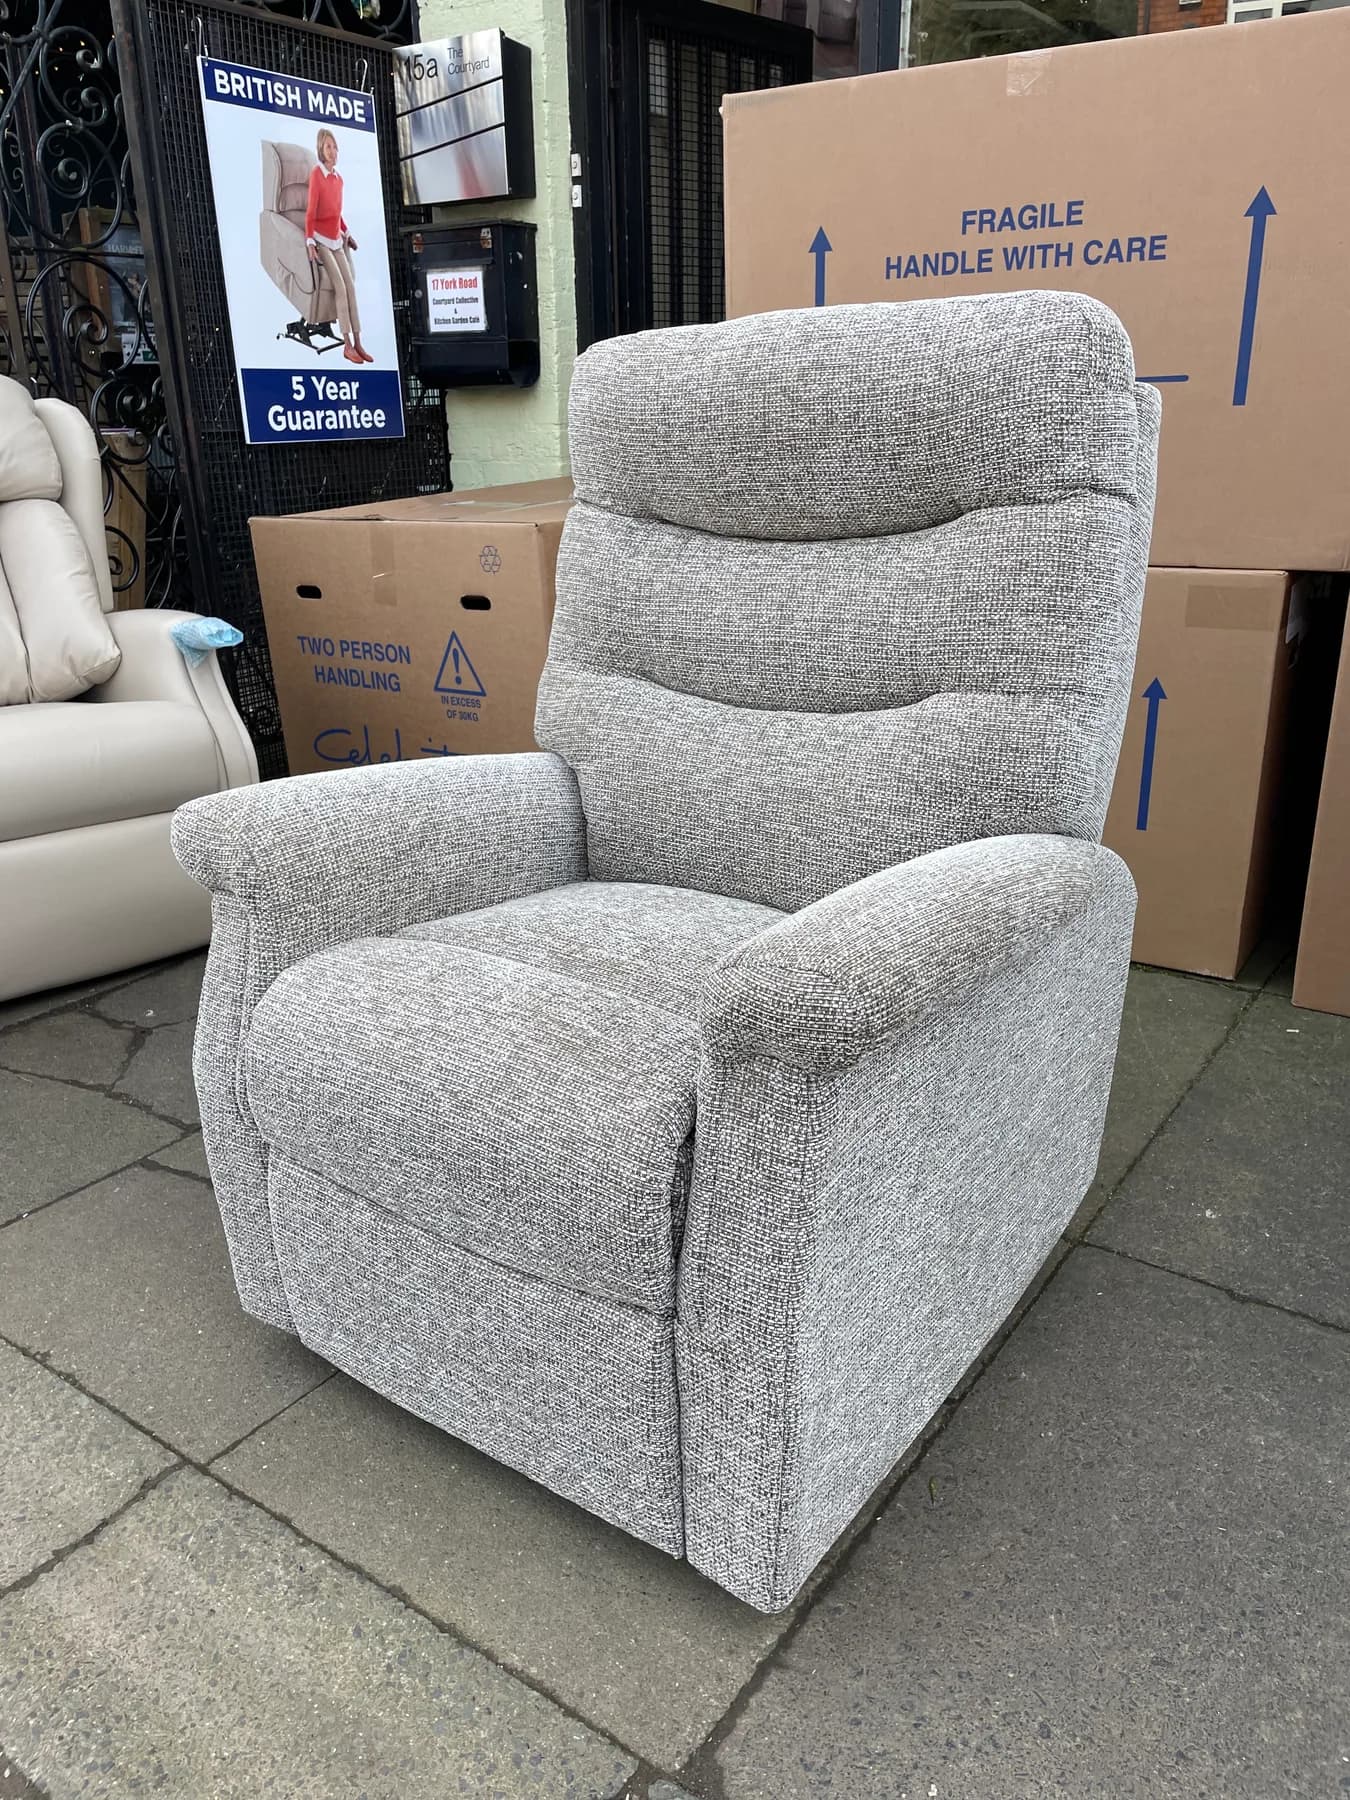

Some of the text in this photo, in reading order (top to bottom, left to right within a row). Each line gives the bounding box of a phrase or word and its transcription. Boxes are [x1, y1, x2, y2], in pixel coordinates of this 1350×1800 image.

[447, 47, 464, 59] The
[447, 56, 490, 75] Courtyard
[404, 53, 439, 82] 15a
[214, 68, 366, 123] BRITISH MADE
[961, 200, 1084, 235] FRAGILE
[885, 235, 1168, 280] HANDLE WITH CARE
[432, 276, 478, 290] 17 York Road
[432, 298, 455, 306] Courtyard
[434, 317, 451, 325] Kitchen
[291, 375, 359, 401] 5 Year
[267, 404, 386, 432] Guarantee
[297, 636, 411, 664] TWO PERSON
[314, 664, 400, 692] HANDLING
[441, 695, 482, 708] IN EXCESS
[446, 709, 457, 719] OF
